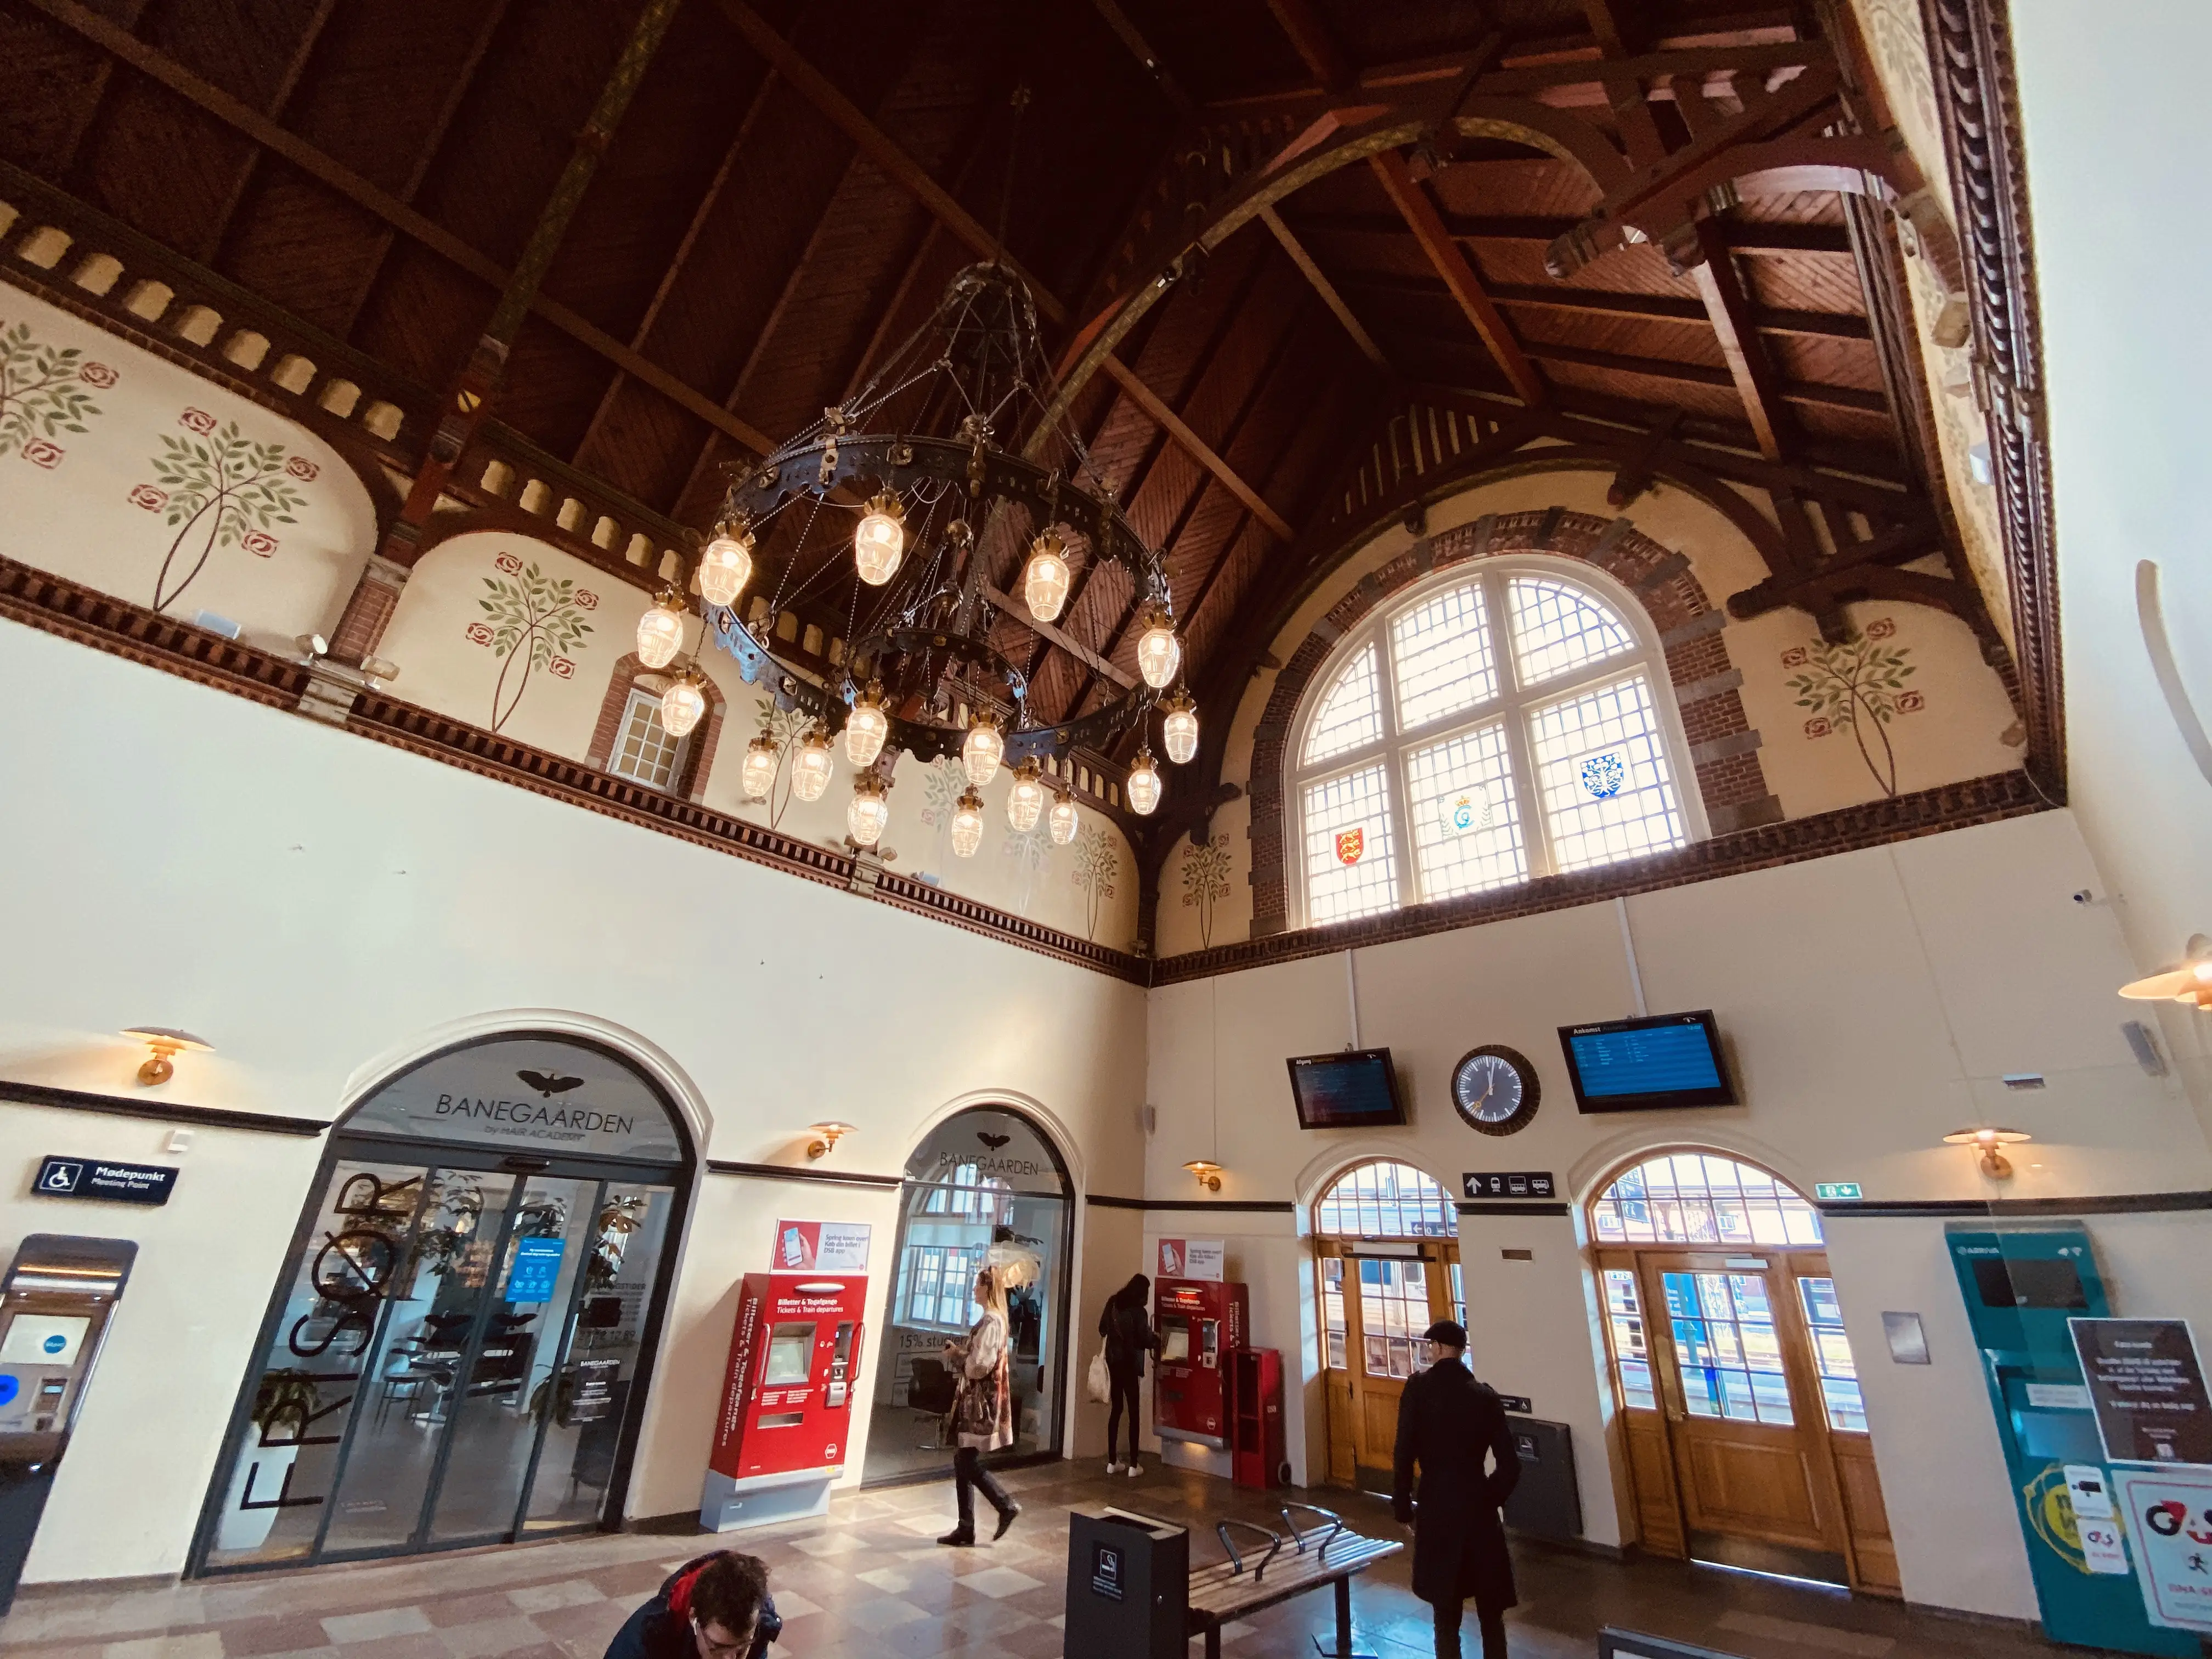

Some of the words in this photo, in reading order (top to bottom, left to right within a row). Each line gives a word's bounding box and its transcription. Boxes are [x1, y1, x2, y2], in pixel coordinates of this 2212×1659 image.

[1573, 1026, 1601, 1035] Ankomst
[435, 1093, 635, 1135] BANEGAARDEN
[484, 1125, 499, 1136] by
[501, 1126, 528, 1137] HAIR
[529, 1129, 586, 1141] ACADEMY
[939, 1152, 1039, 1176] BANEGAARDEN
[95, 1166, 166, 1182] Mødepunkt
[825, 1234, 842, 1243] Spring
[240, 1173, 421, 1510] FRISØR
[900, 1334, 923, 1348] 15%
